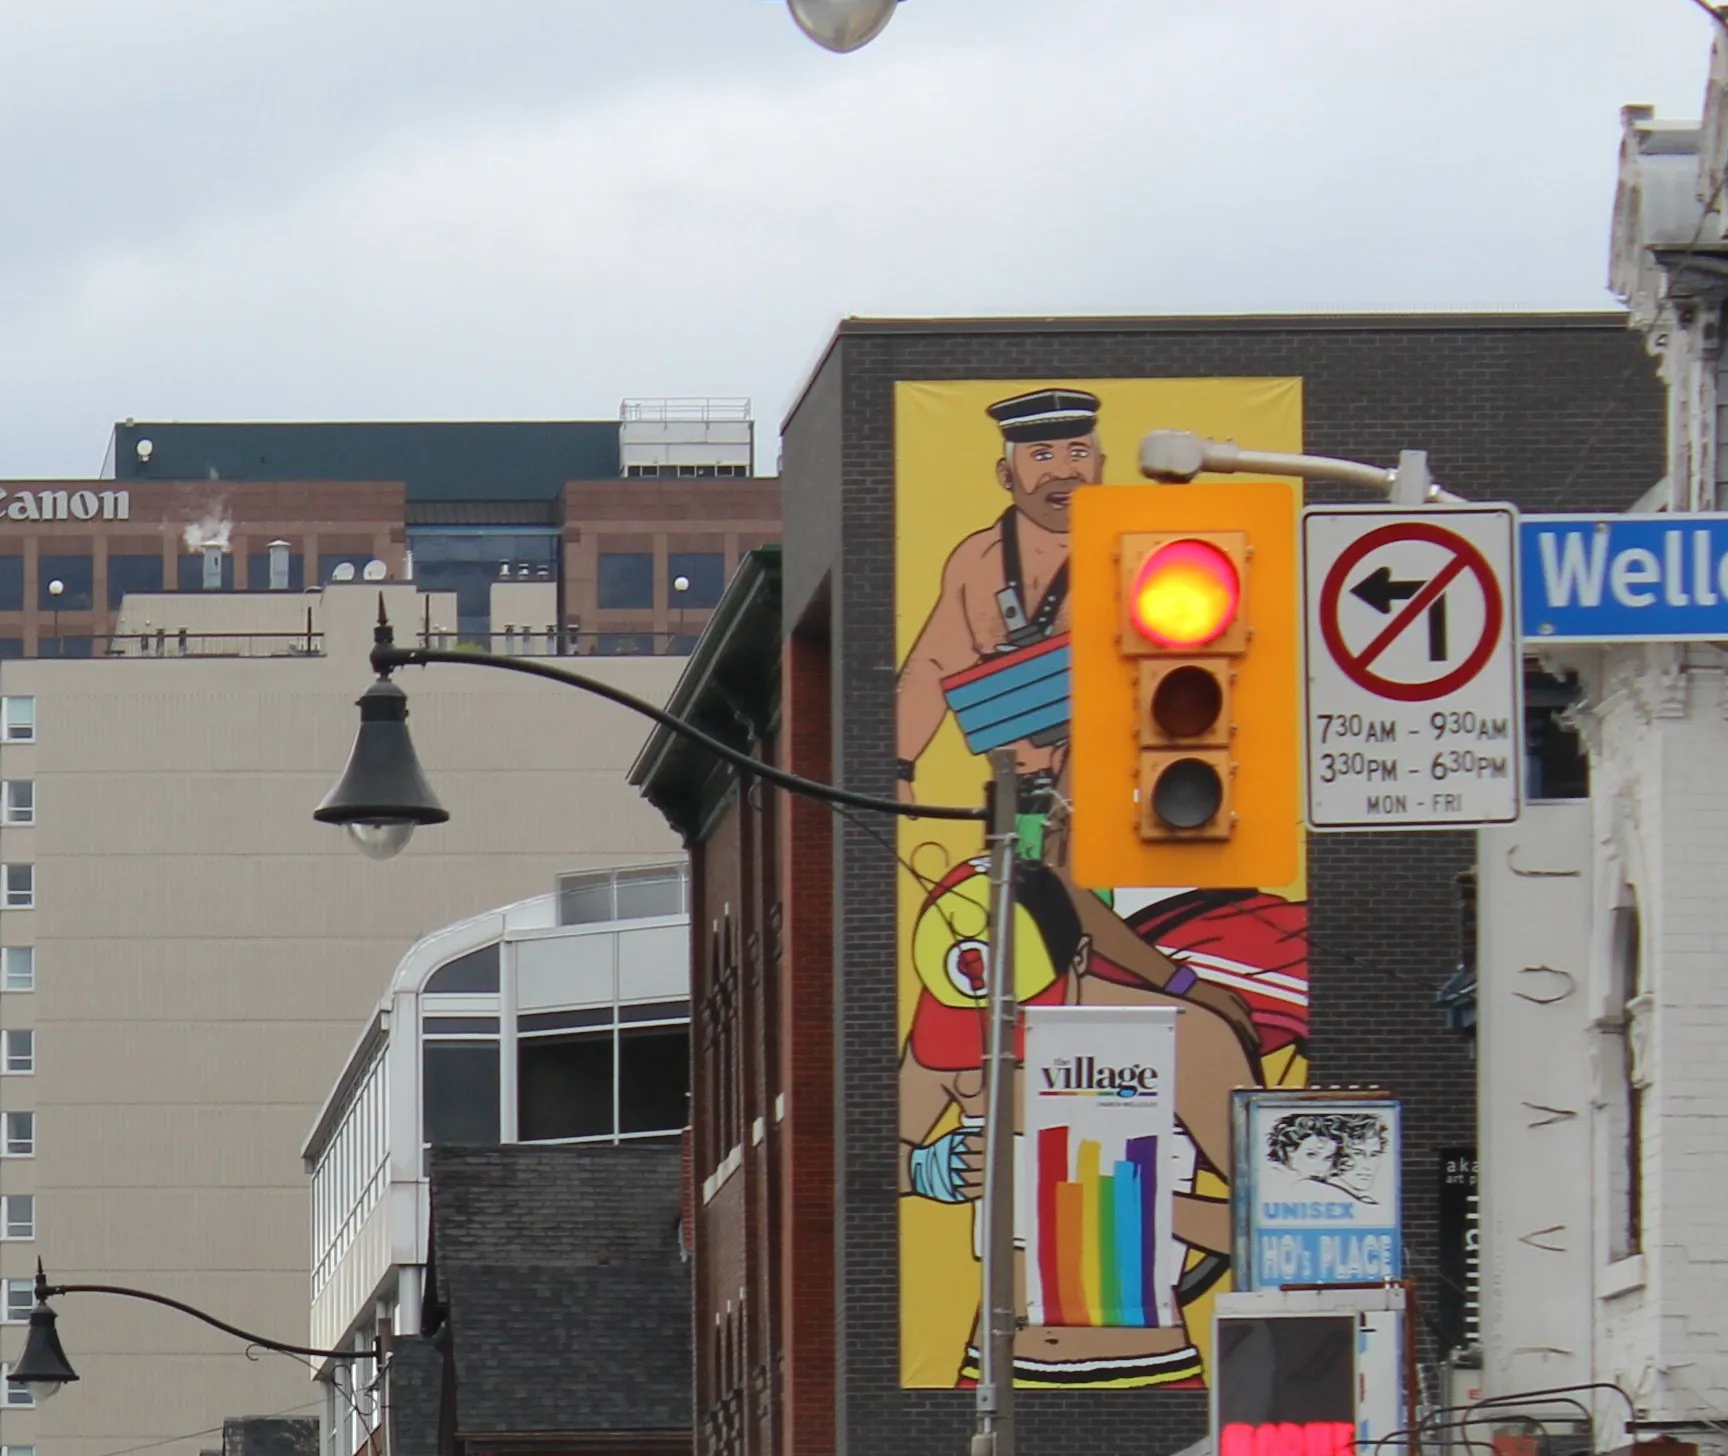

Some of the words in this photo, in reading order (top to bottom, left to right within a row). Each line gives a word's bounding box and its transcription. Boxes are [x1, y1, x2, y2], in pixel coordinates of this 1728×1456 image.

[1538, 529, 1728, 608] Well
[1366, 794, 1407, 815] MON
[1432, 793, 1462, 813] FRI
[1041, 1055, 1159, 1098] village
[1263, 1201, 1354, 1220] UNISEX
[1319, 1234, 1393, 1280] PLACE
